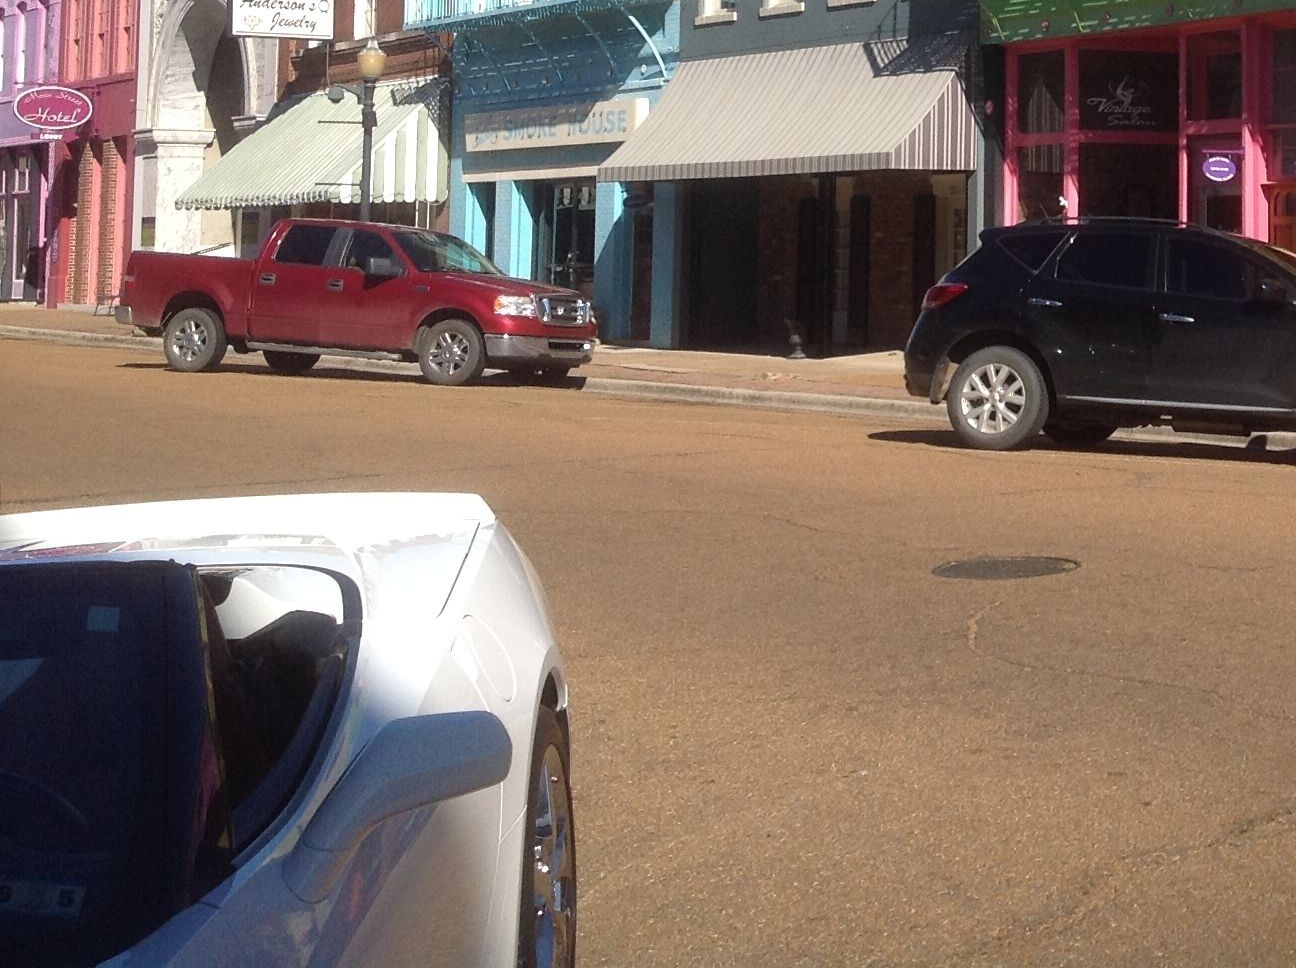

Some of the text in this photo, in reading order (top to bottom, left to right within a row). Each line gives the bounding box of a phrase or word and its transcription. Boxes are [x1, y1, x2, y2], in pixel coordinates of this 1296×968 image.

[270, 12, 317, 33] Jewelry
[24, 107, 81, 123] Hotel
[1086, 98, 1151, 119] Vintage
[502, 115, 557, 140] SMOKE
[568, 109, 627, 137] HOUSE
